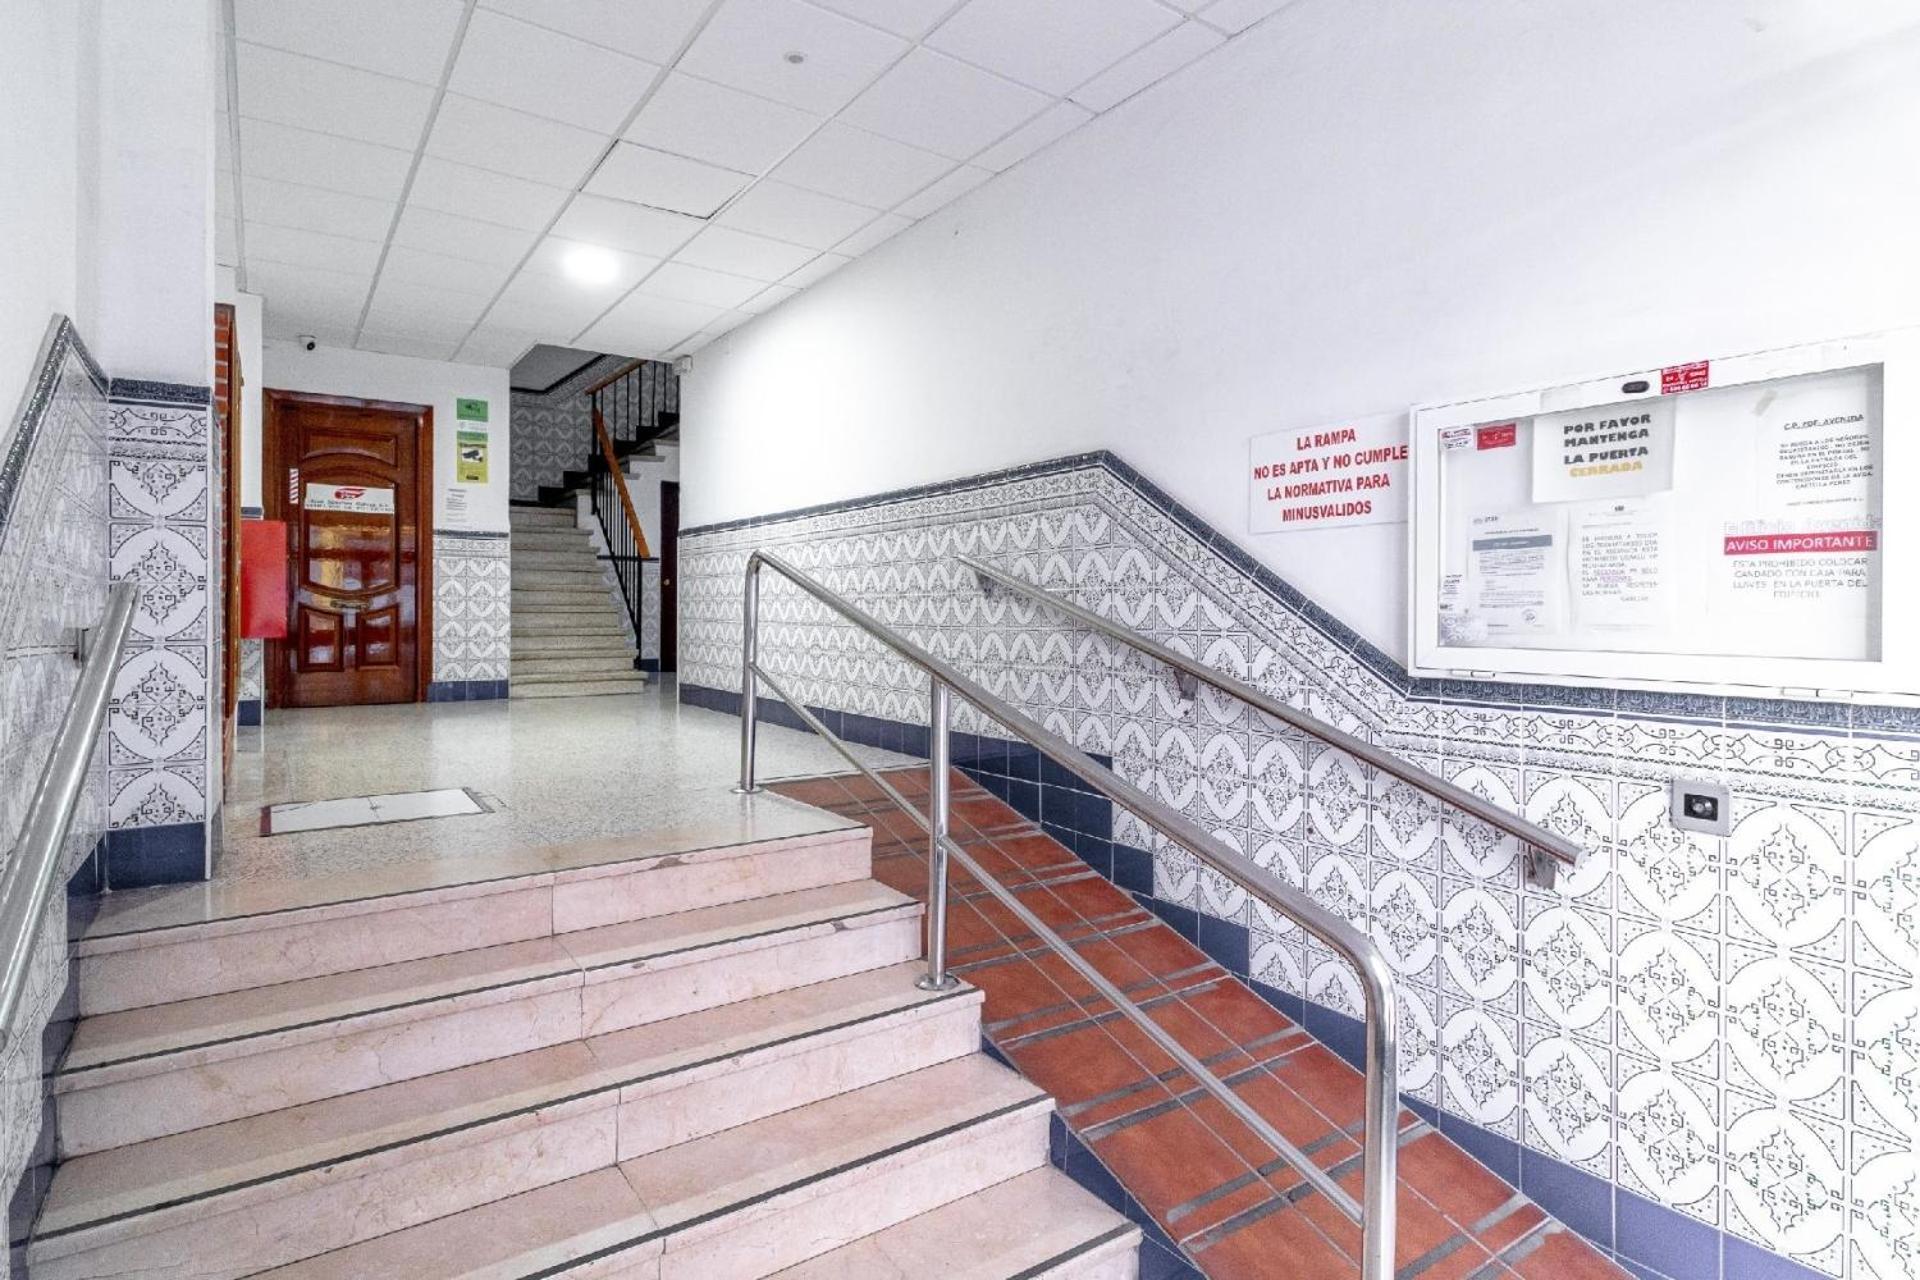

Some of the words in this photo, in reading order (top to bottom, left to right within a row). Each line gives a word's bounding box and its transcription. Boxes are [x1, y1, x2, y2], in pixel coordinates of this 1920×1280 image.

[1564, 422, 1595, 435] POR
[1600, 414, 1651, 431] FAVOR
[1297, 437, 1312, 451] LA
[1315, 429, 1356, 448] RAMPA
[1564, 428, 1650, 447] MANTENGA
[1254, 466, 1270, 480] NO
[1272, 464, 1286, 477] ES
[1289, 458, 1319, 475] APTA
[1322, 457, 1330, 471] Y
[1334, 454, 1351, 469] NO
[1354, 445, 1408, 466] CUMPLE
[1564, 454, 1584, 465] LA
[1589, 446, 1649, 463] PUERTA
[1570, 461, 1643, 477] CERRADA
[1268, 488, 1282, 501] LA
[1284, 478, 1352, 499] NORMATIVA
[1356, 473, 1390, 490] PARA
[1283, 501, 1372, 522] MINUSVALIDOS
[1727, 540, 1769, 551] AVISO
[1773, 535, 1873, 550] IMPORTANTE
[1734, 569, 1783, 578] CANDADO
[1847, 579, 1868, 588] DEL
